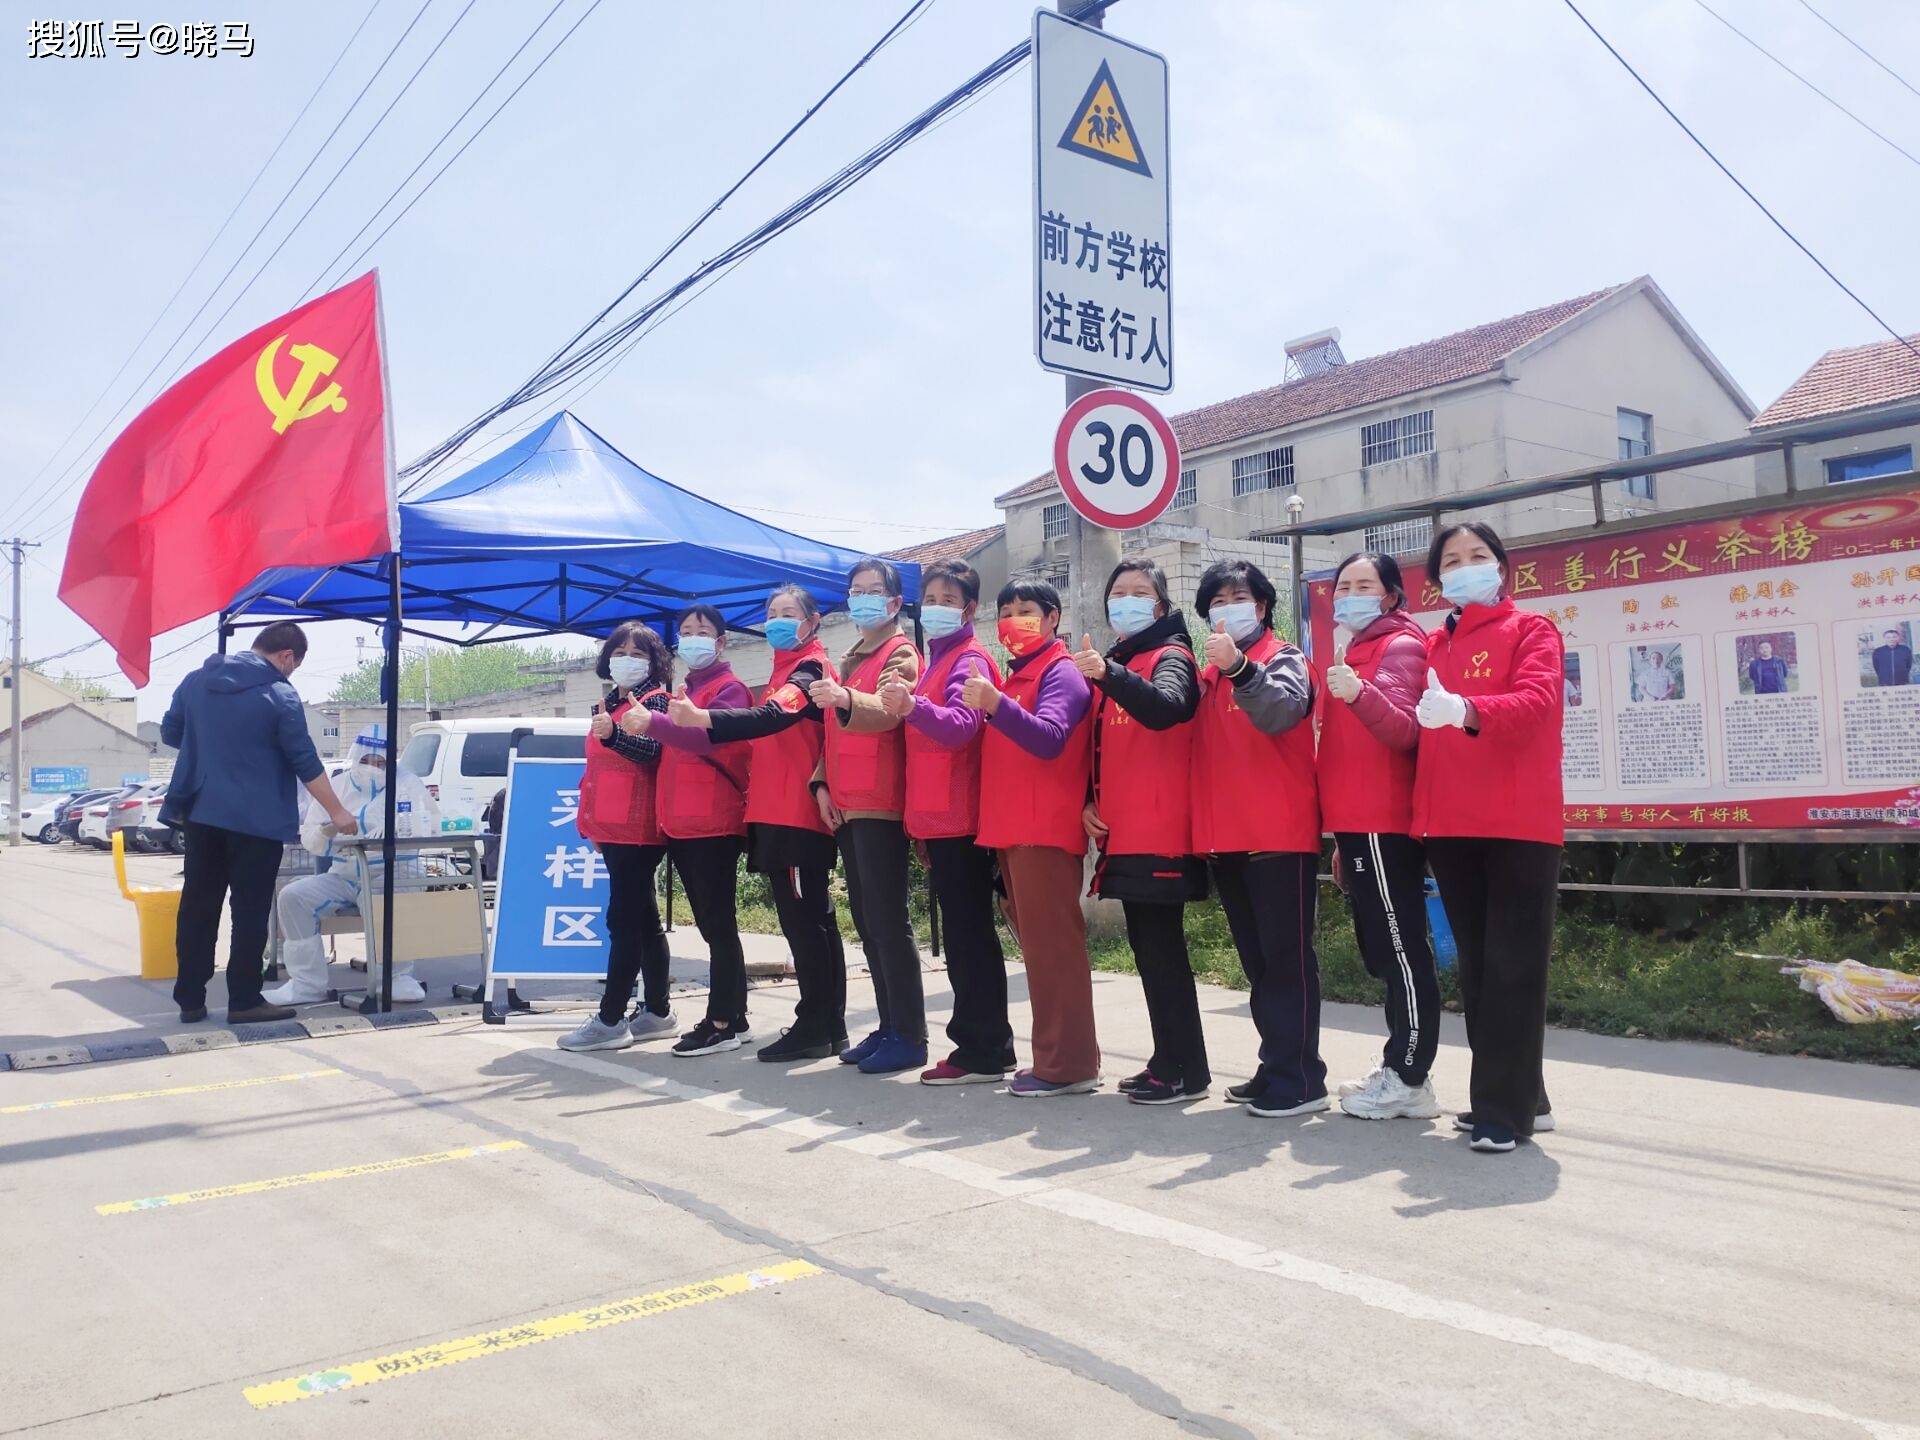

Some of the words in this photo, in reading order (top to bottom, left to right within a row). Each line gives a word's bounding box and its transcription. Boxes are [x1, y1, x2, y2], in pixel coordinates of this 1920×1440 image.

[1040, 210, 1167, 292] 前方学校
[1043, 290, 1168, 369] 注意行人
[1080, 420, 1154, 487] 30
[1421, 519, 1819, 606] 区善行义举榜
[1620, 807, 1680, 823] 当好人
[1687, 805, 1753, 823] 有好报
[1386, 912, 1403, 952] DEGREE
[376, 1328, 545, 1374] 防控一米线
